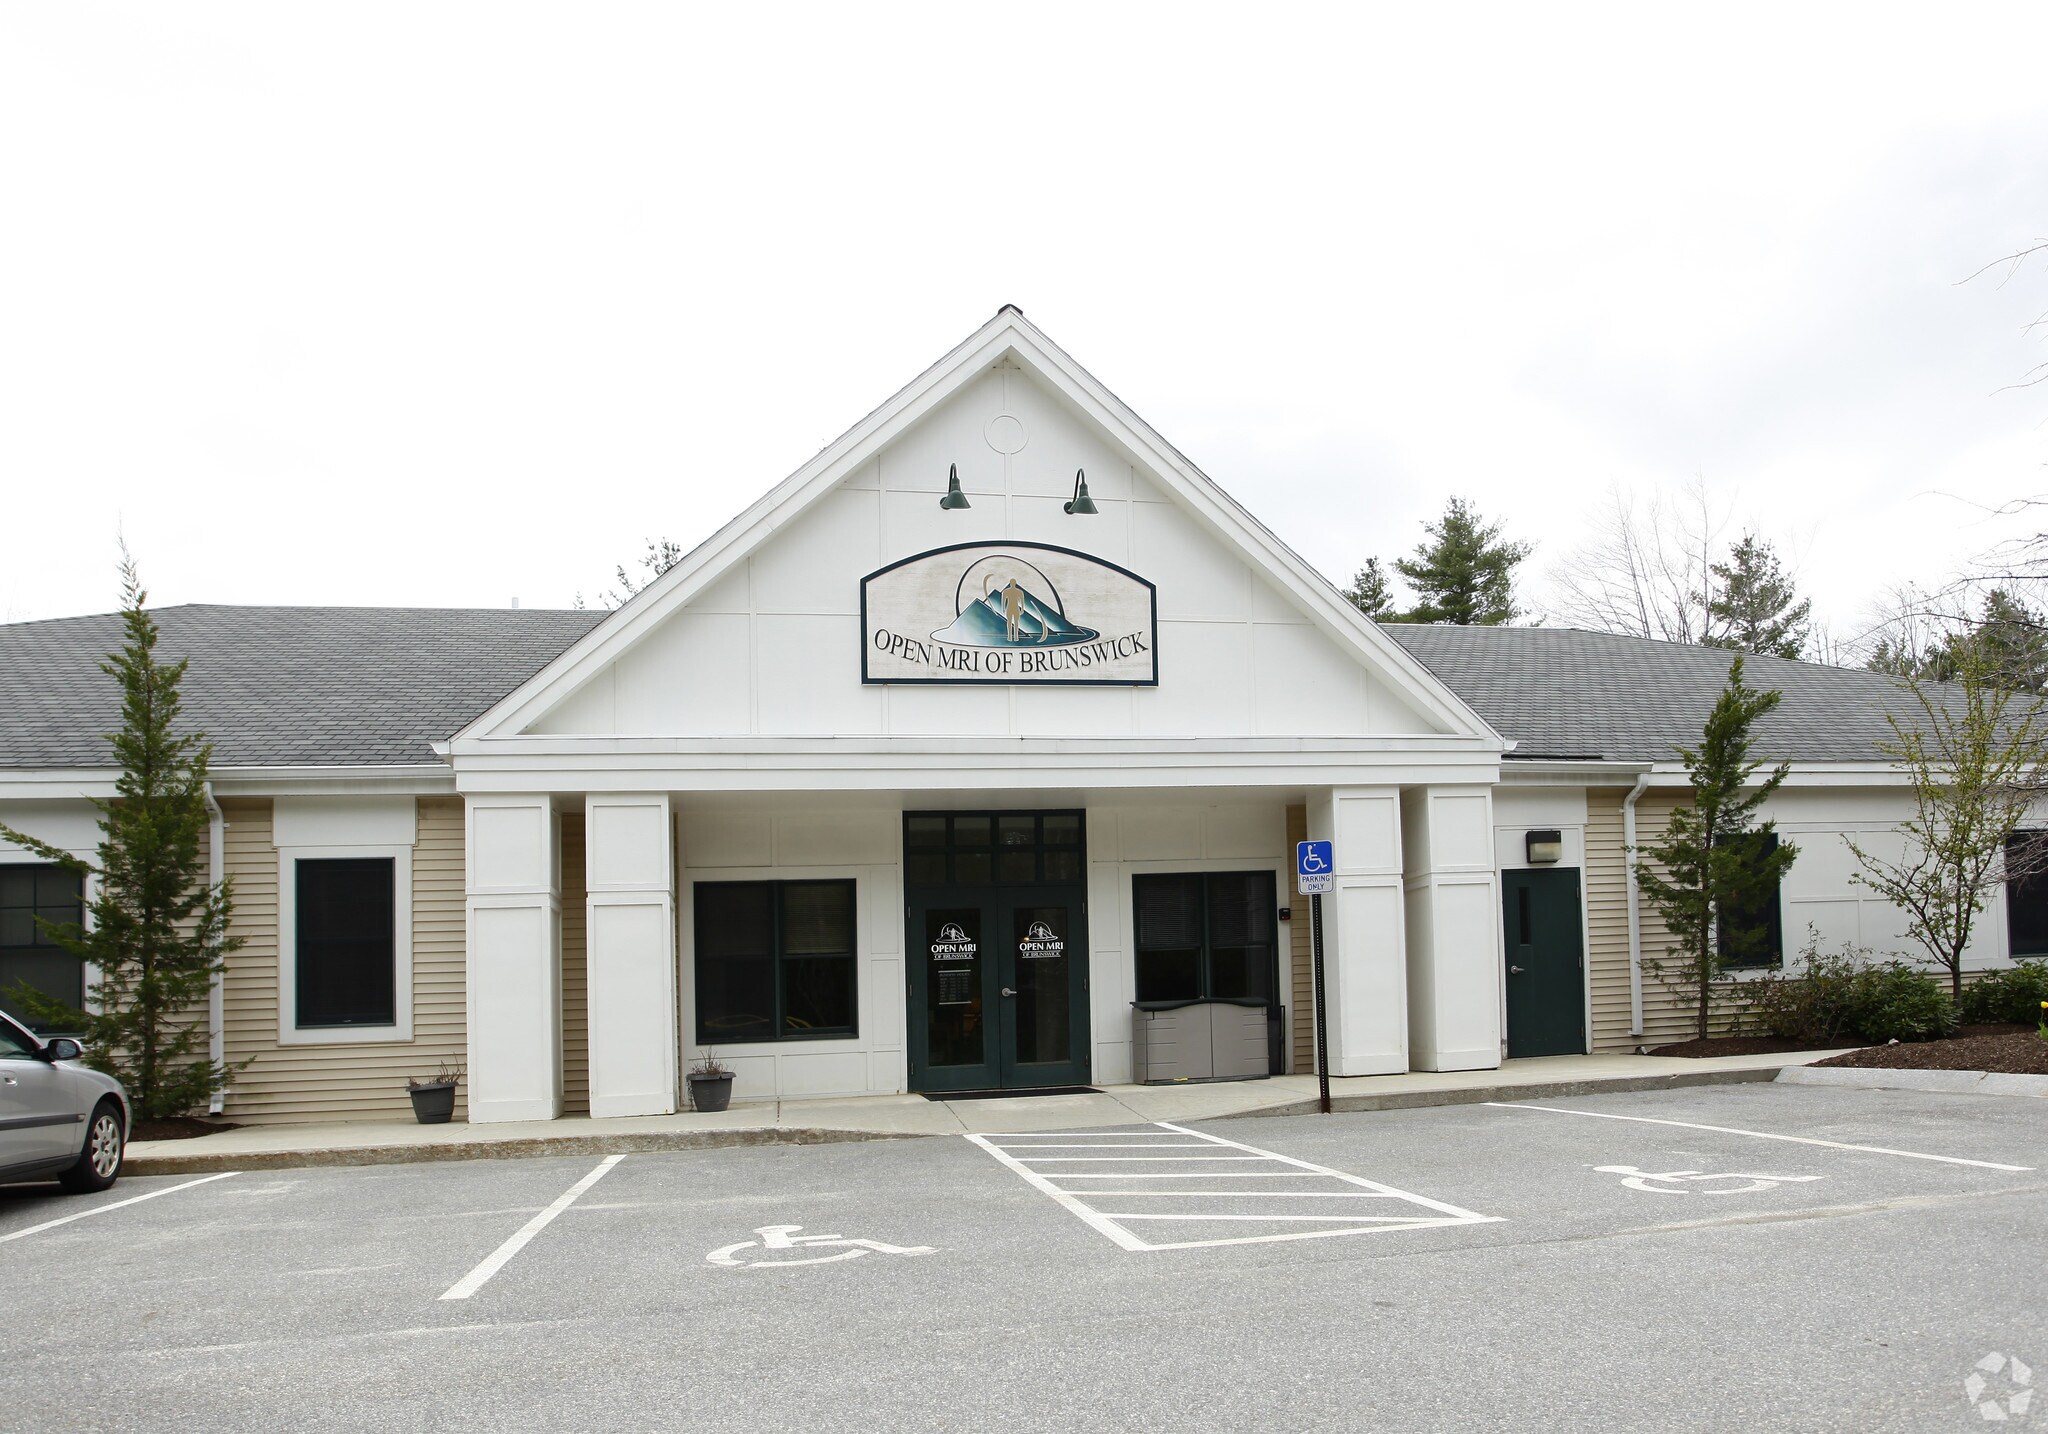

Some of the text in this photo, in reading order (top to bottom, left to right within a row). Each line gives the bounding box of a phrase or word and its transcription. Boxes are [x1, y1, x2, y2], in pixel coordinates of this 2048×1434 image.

[874, 628, 1149, 674] OPEN MRI OF BRUNSWICK
[1302, 875, 1330, 883] PARKING
[1308, 883, 1325, 891] ONLY
[931, 943, 977, 953] OPEN MRI
[1019, 941, 1064, 951] OPEN MRI
